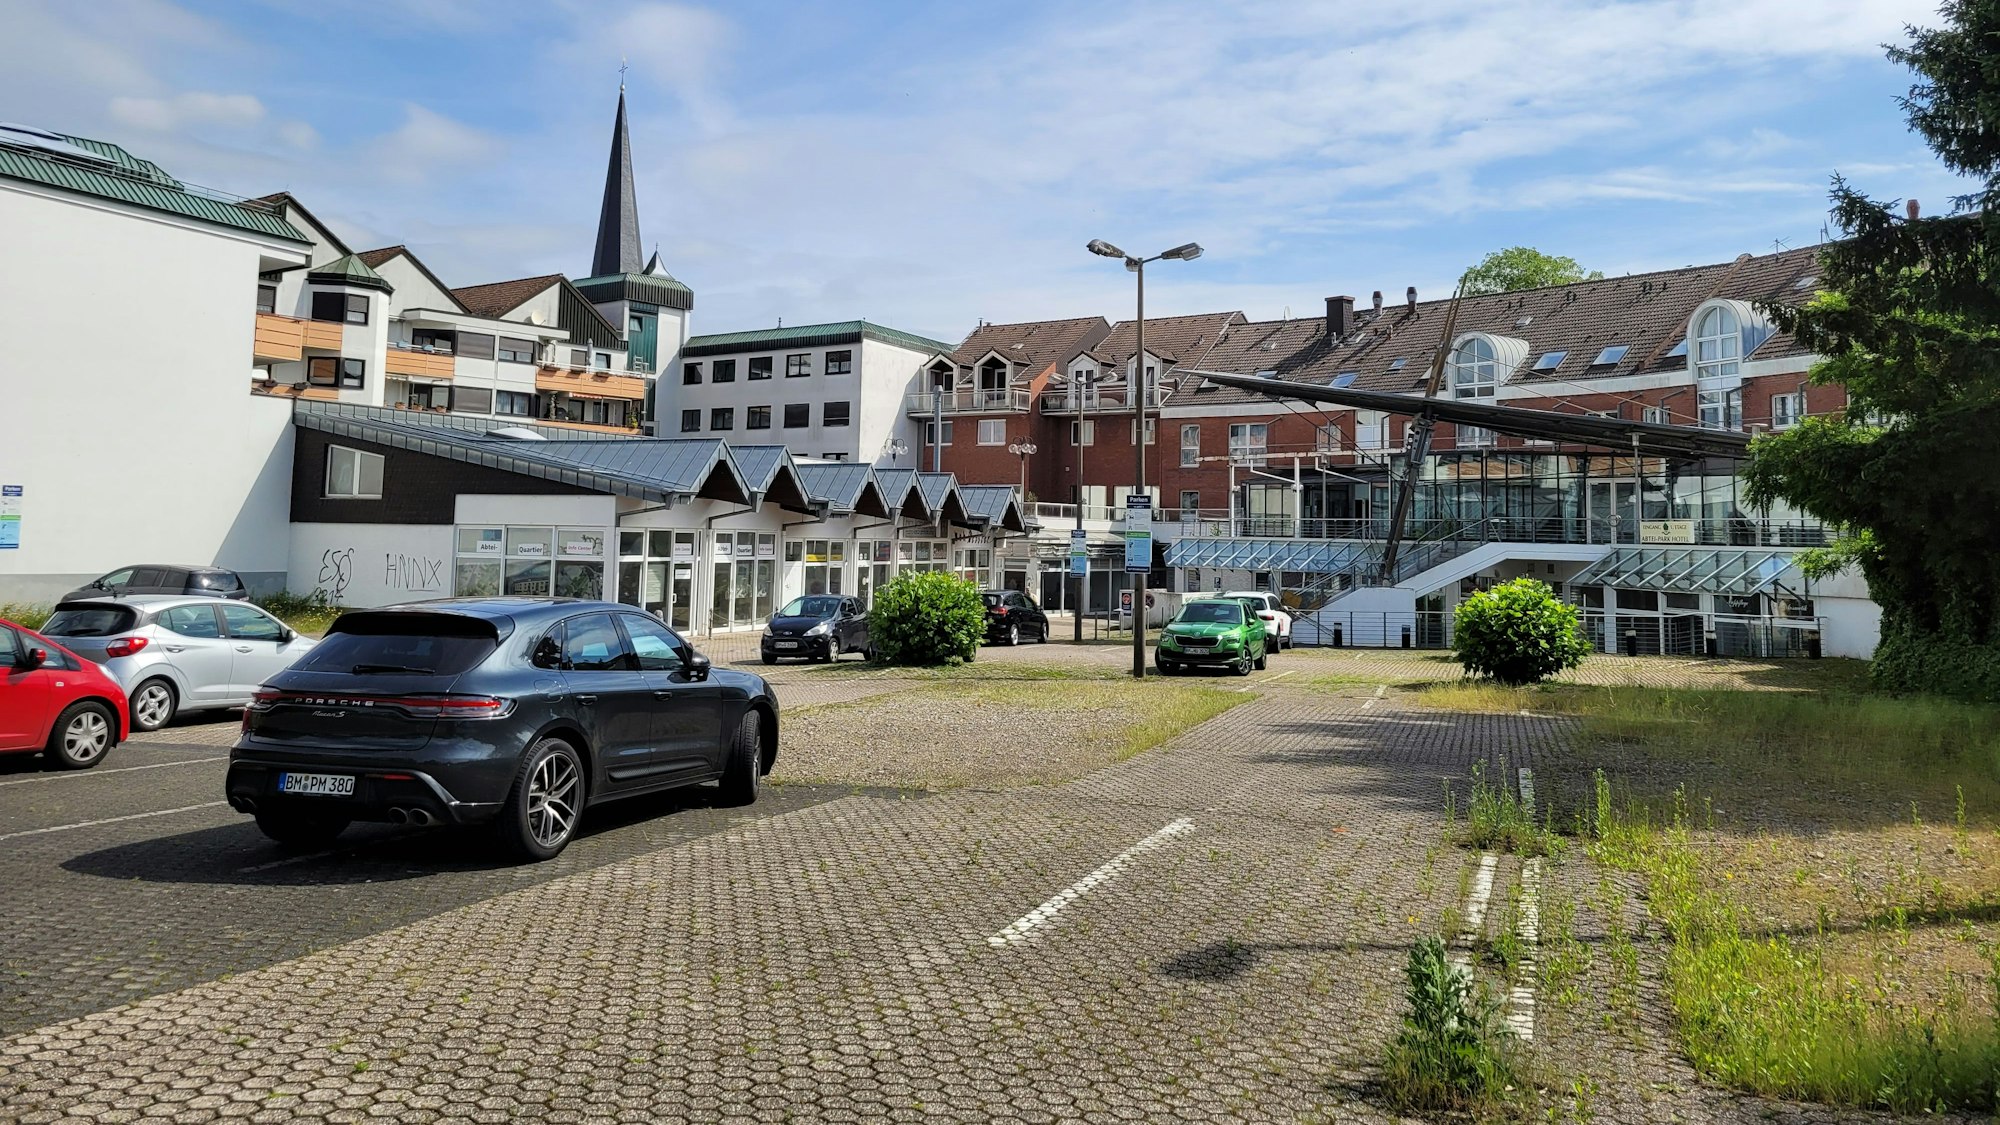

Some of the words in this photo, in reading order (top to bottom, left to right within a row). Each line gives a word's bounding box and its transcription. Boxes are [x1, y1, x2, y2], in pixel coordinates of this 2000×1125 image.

[480, 543, 498, 551] Abtei-
[519, 546, 543, 554] Quartier
[295, 698, 375, 706] PORSCHE
[285, 775, 302, 791] BM
[310, 776, 327, 791] PM
[328, 777, 354, 793] 380
